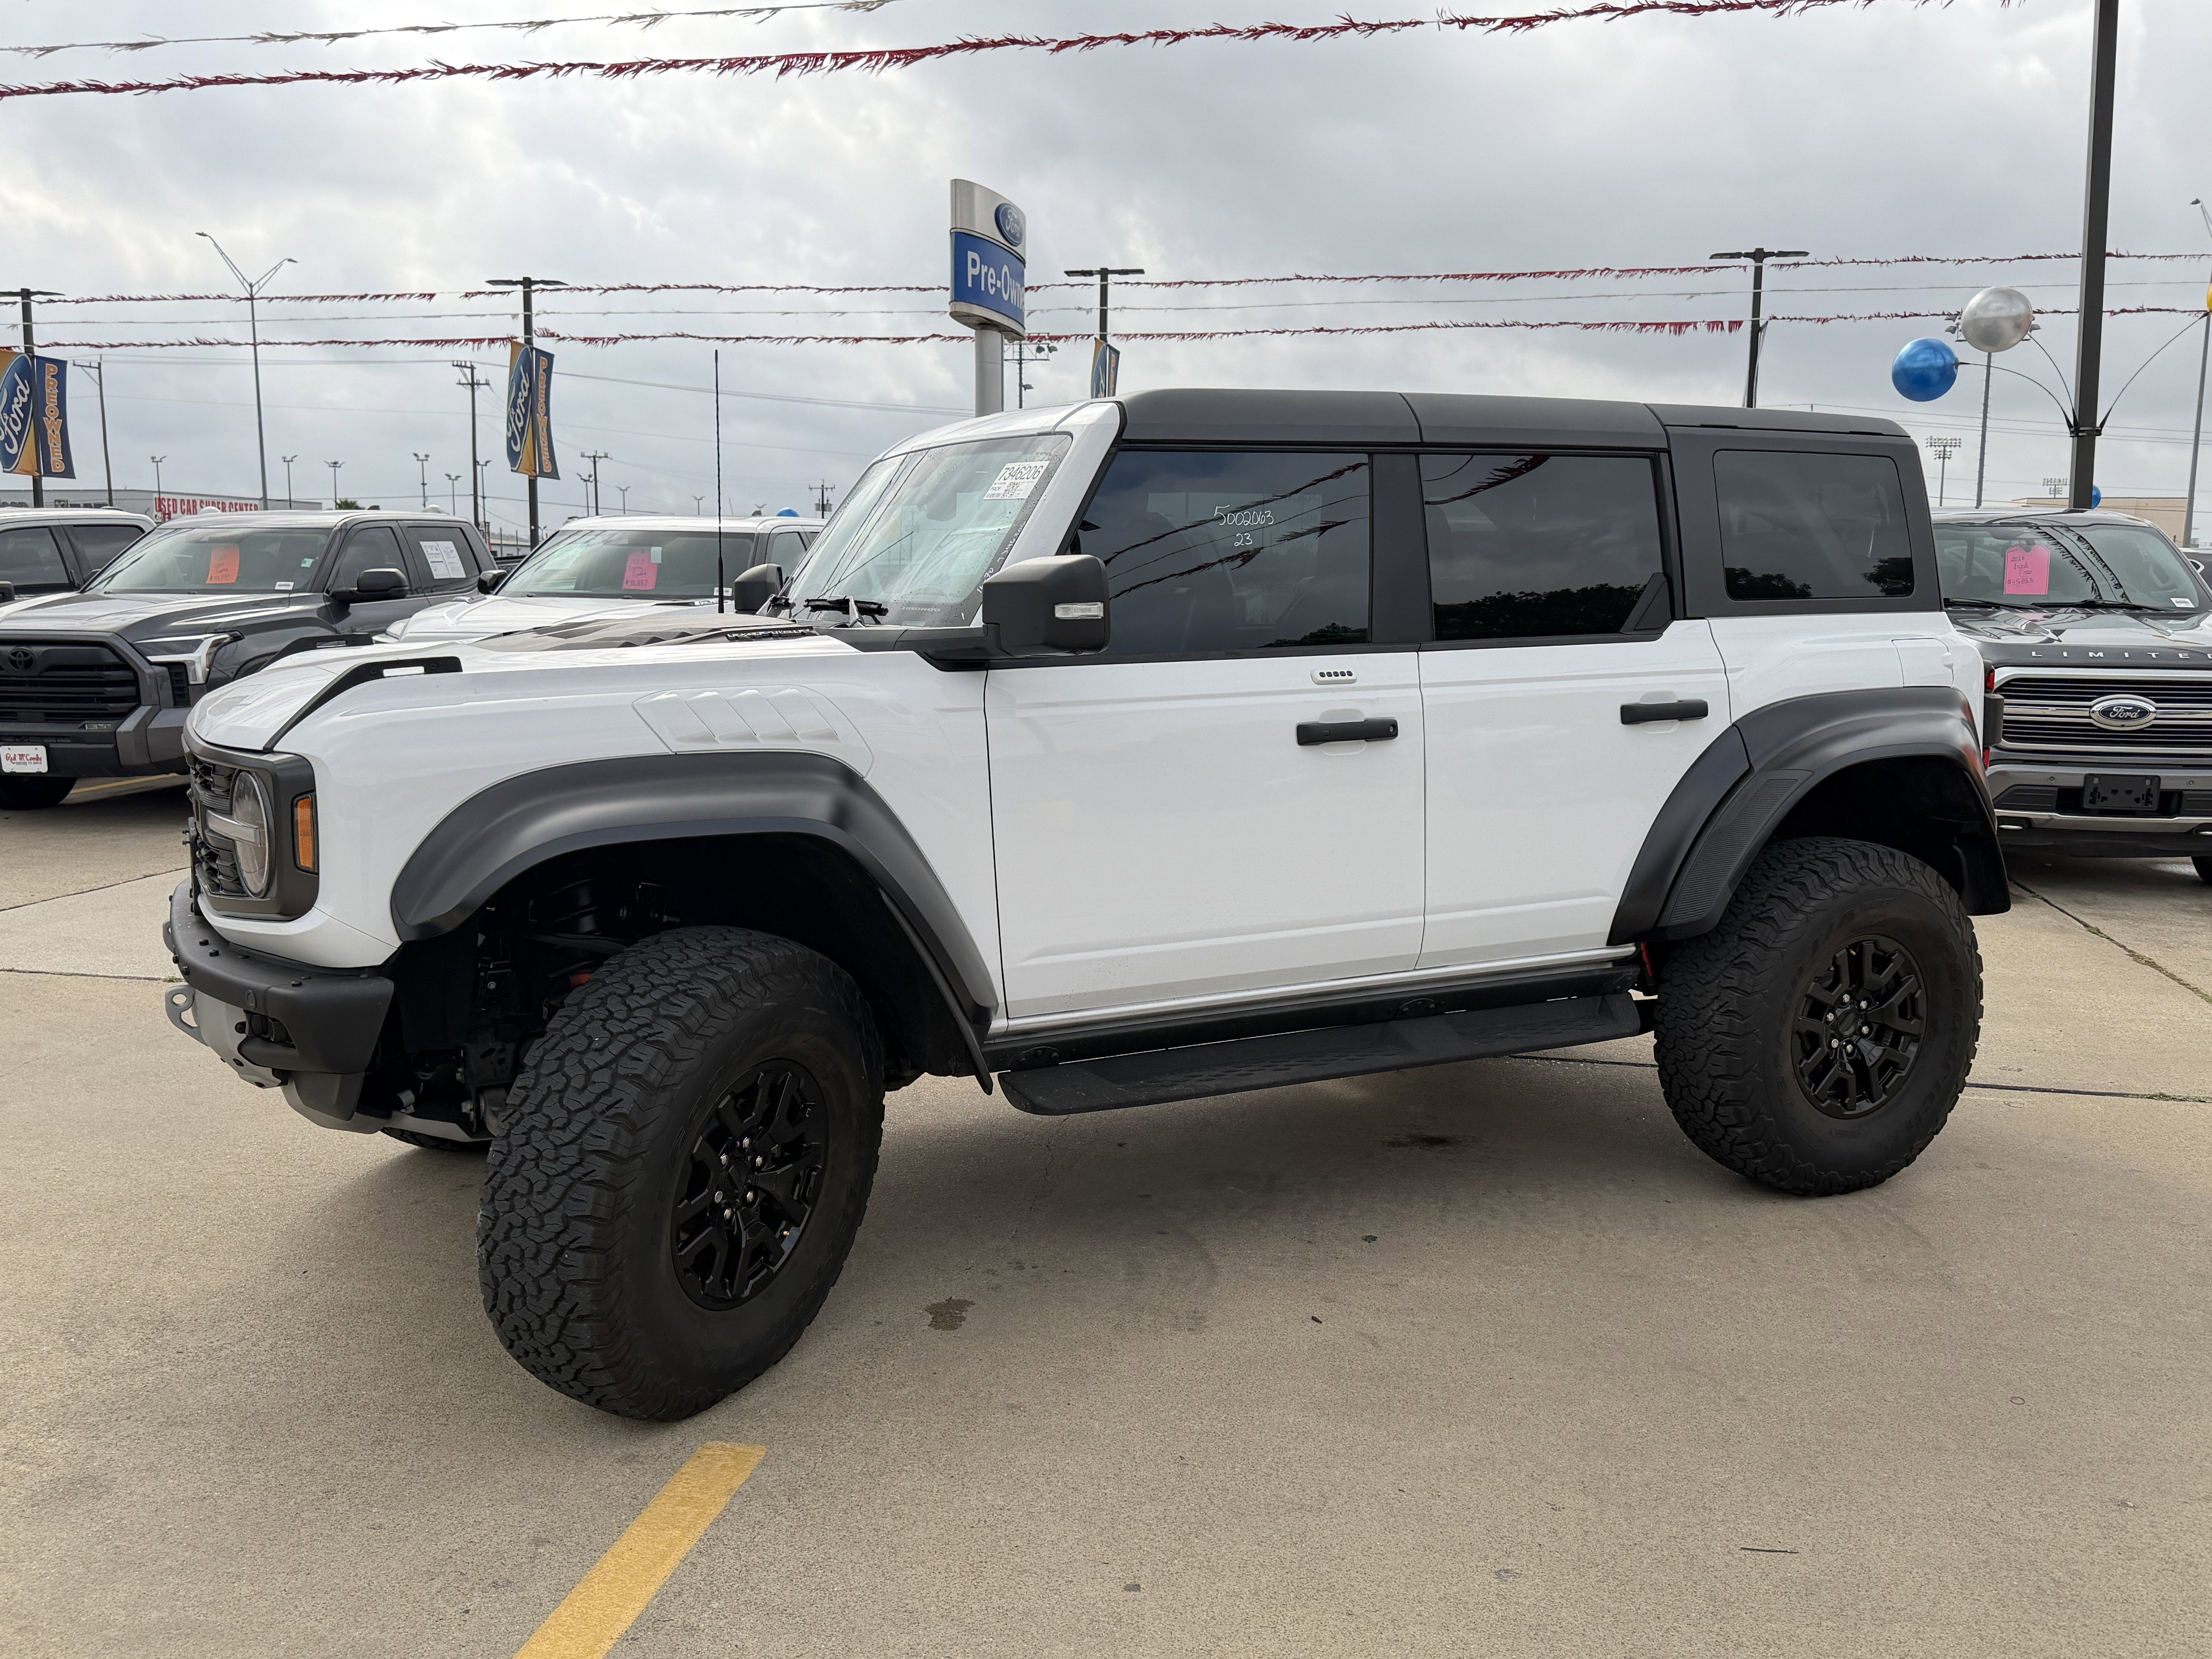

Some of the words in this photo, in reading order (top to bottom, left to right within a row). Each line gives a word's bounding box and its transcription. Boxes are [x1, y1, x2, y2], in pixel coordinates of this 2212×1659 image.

[0, 373, 29, 454] Ford
[507, 364, 531, 452] Ford
[998, 465, 1043, 481] 7346206
[155, 497, 177, 514] USED
[180, 499, 198, 515] CAR
[1214, 505, 1274, 526] 5002063
[1234, 533, 1253, 547] 23
[2109, 706, 2140, 719] Ford
